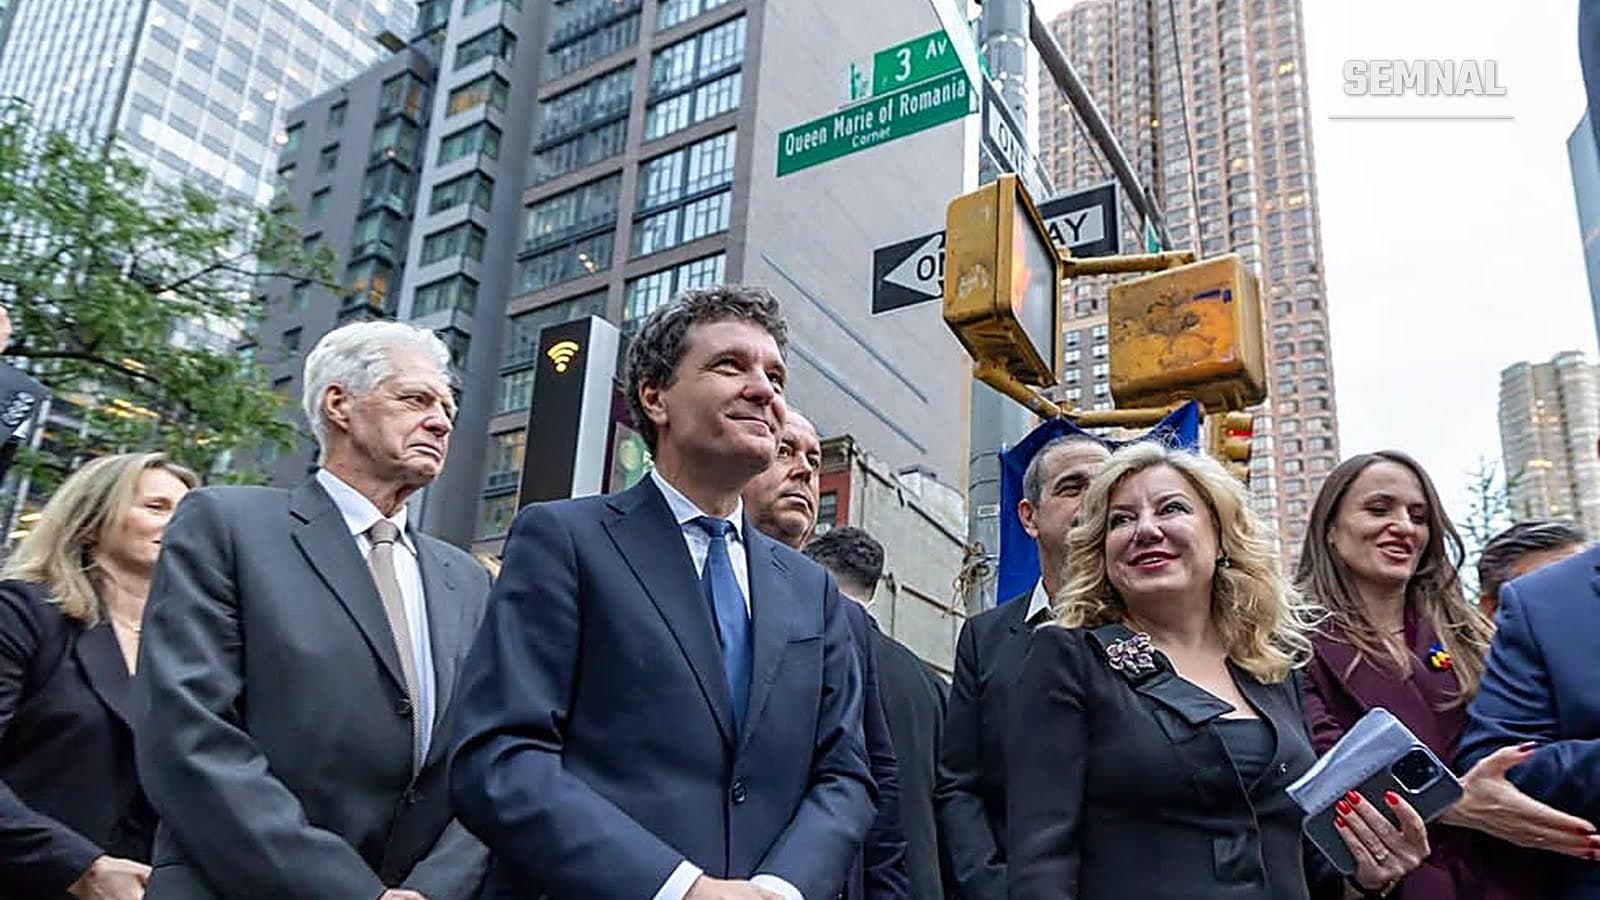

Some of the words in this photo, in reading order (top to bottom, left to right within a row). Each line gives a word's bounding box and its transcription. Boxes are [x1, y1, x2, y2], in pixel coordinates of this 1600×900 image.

[894, 47, 912, 82] 3
[785, 126, 828, 157] Queen
[833, 108, 873, 140] Marie
[879, 98, 894, 124] of
[900, 76, 966, 117] Romania
[851, 126, 892, 148] Corner
[1048, 212, 1089, 246] AY
